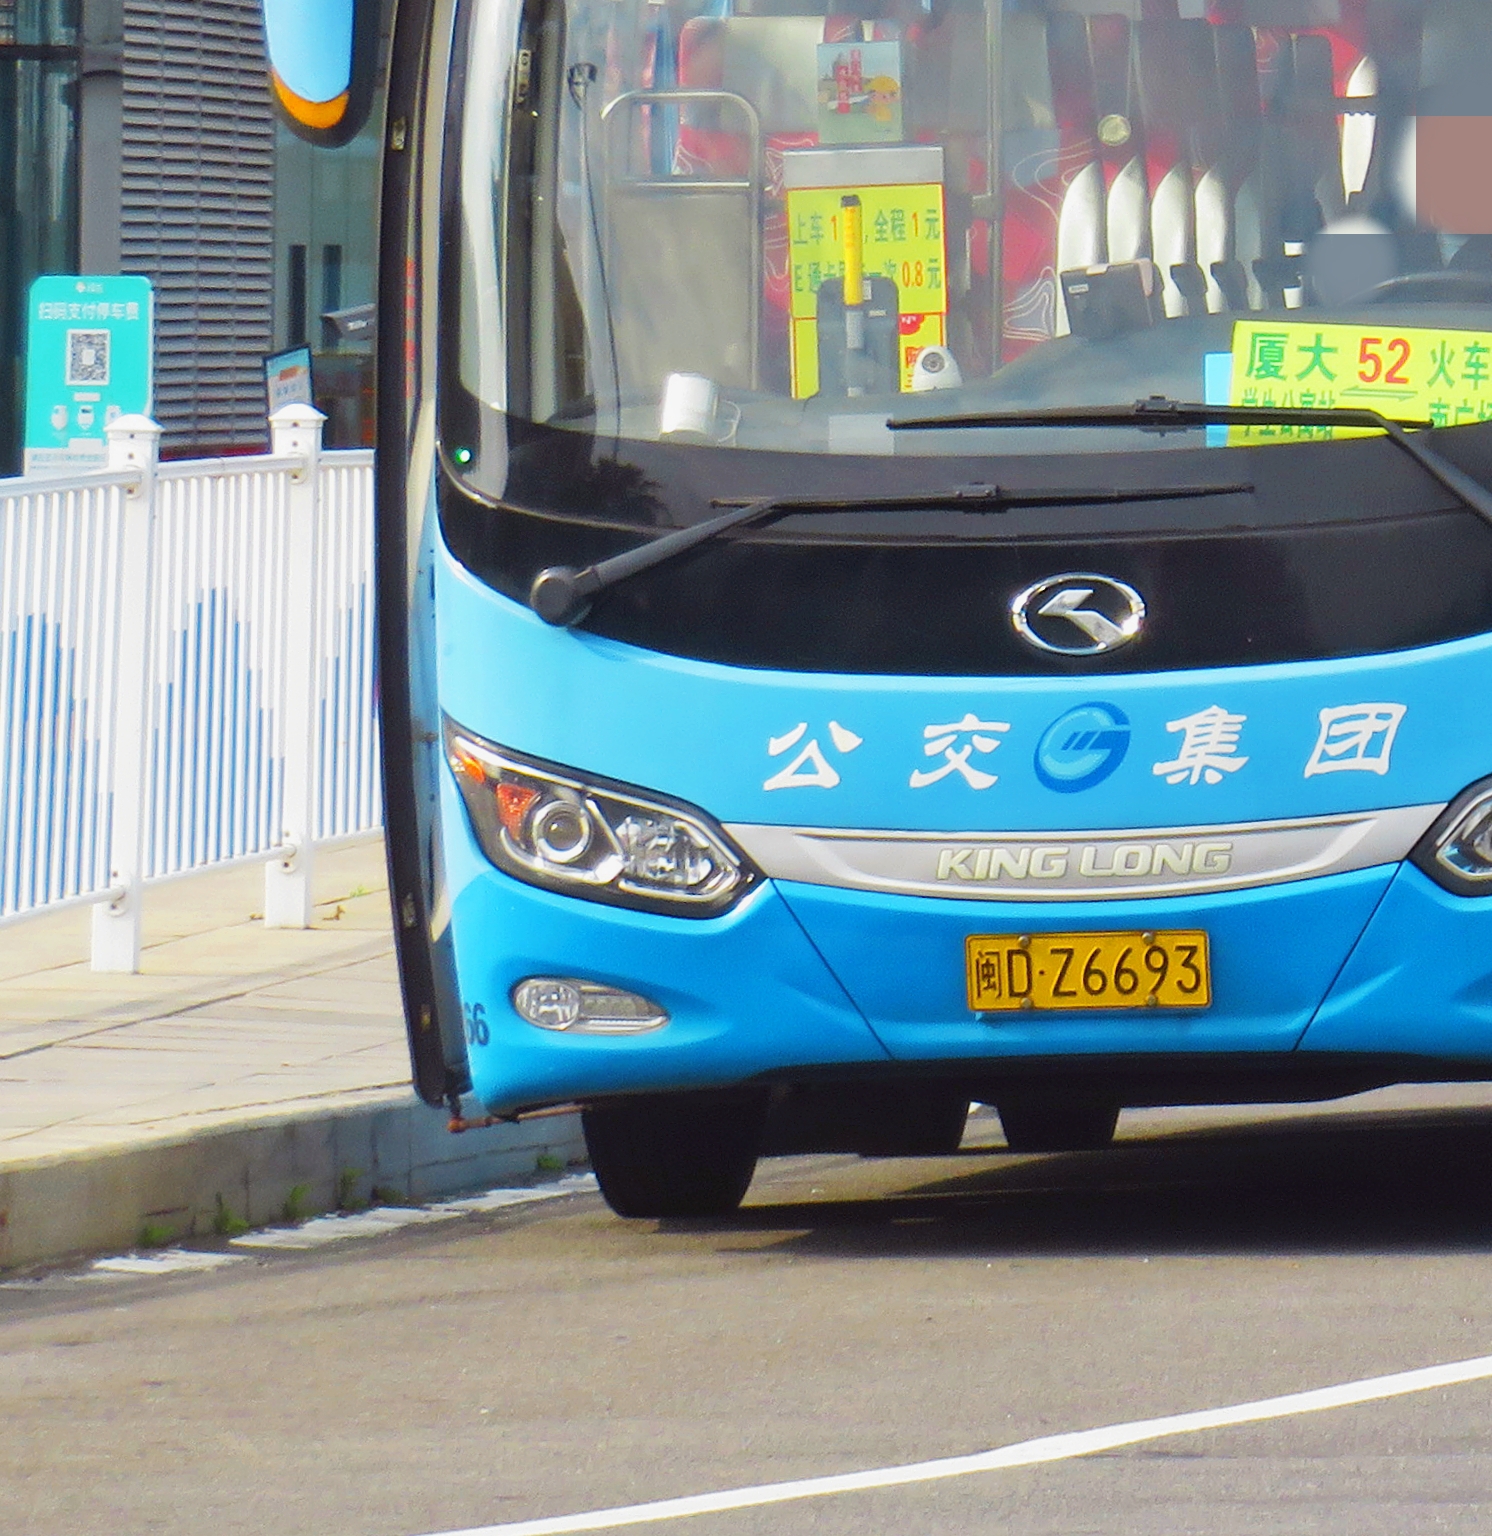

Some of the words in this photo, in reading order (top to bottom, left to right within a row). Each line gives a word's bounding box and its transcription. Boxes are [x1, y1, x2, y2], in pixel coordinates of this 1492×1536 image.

[1245, 331, 1337, 383] 厦大
[1357, 337, 1411, 385] 52
[763, 702, 1408, 793] 公交集团
[936, 844, 1067, 880] KING
[1078, 842, 1233, 878] LONG
[975, 943, 1202, 1001] 闽D·Z6693
